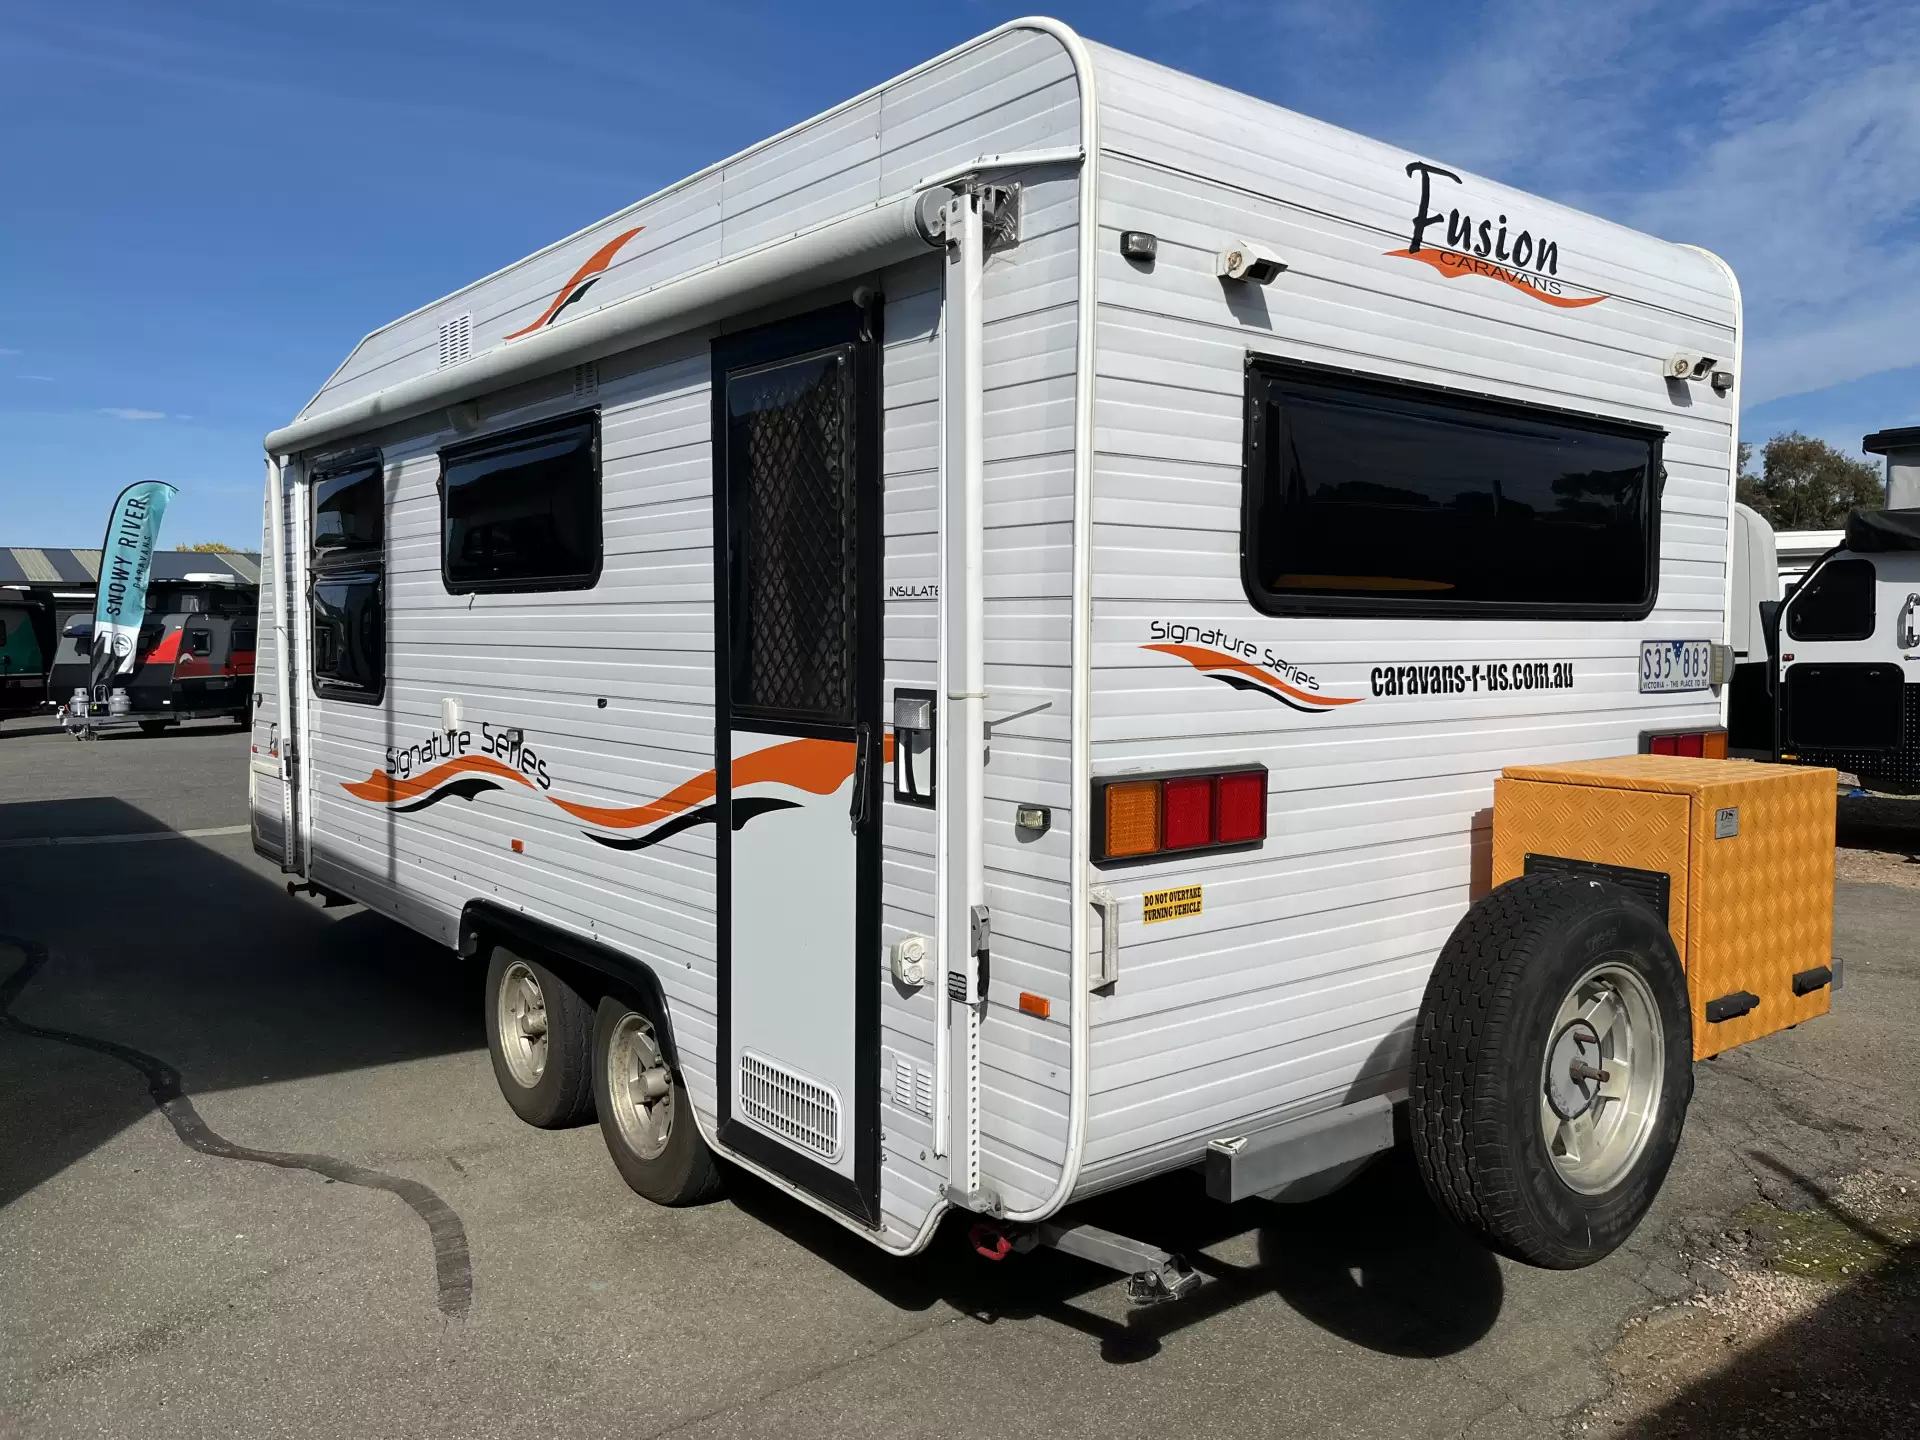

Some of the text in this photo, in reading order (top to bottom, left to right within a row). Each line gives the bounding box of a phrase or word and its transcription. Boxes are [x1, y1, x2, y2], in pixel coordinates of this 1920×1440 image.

[1405, 161, 1558, 276] Fusion
[1439, 252, 1562, 295] CARAVANS
[118, 498, 147, 549] RIVER
[106, 555, 133, 616] SNOWY
[1150, 620, 1320, 691] Signature Series
[1371, 662, 1574, 697] caravans-r-us.com.au
[1643, 681, 1665, 690] VICTORIA
[1670, 680, 1679, 688] THE
[1680, 680, 1694, 688] PLACE
[386, 731, 471, 779] Signature
[1144, 887, 1202, 907] DO NOT OVERTAKE
[1144, 901, 1201, 922] TURNING VEHICLE
